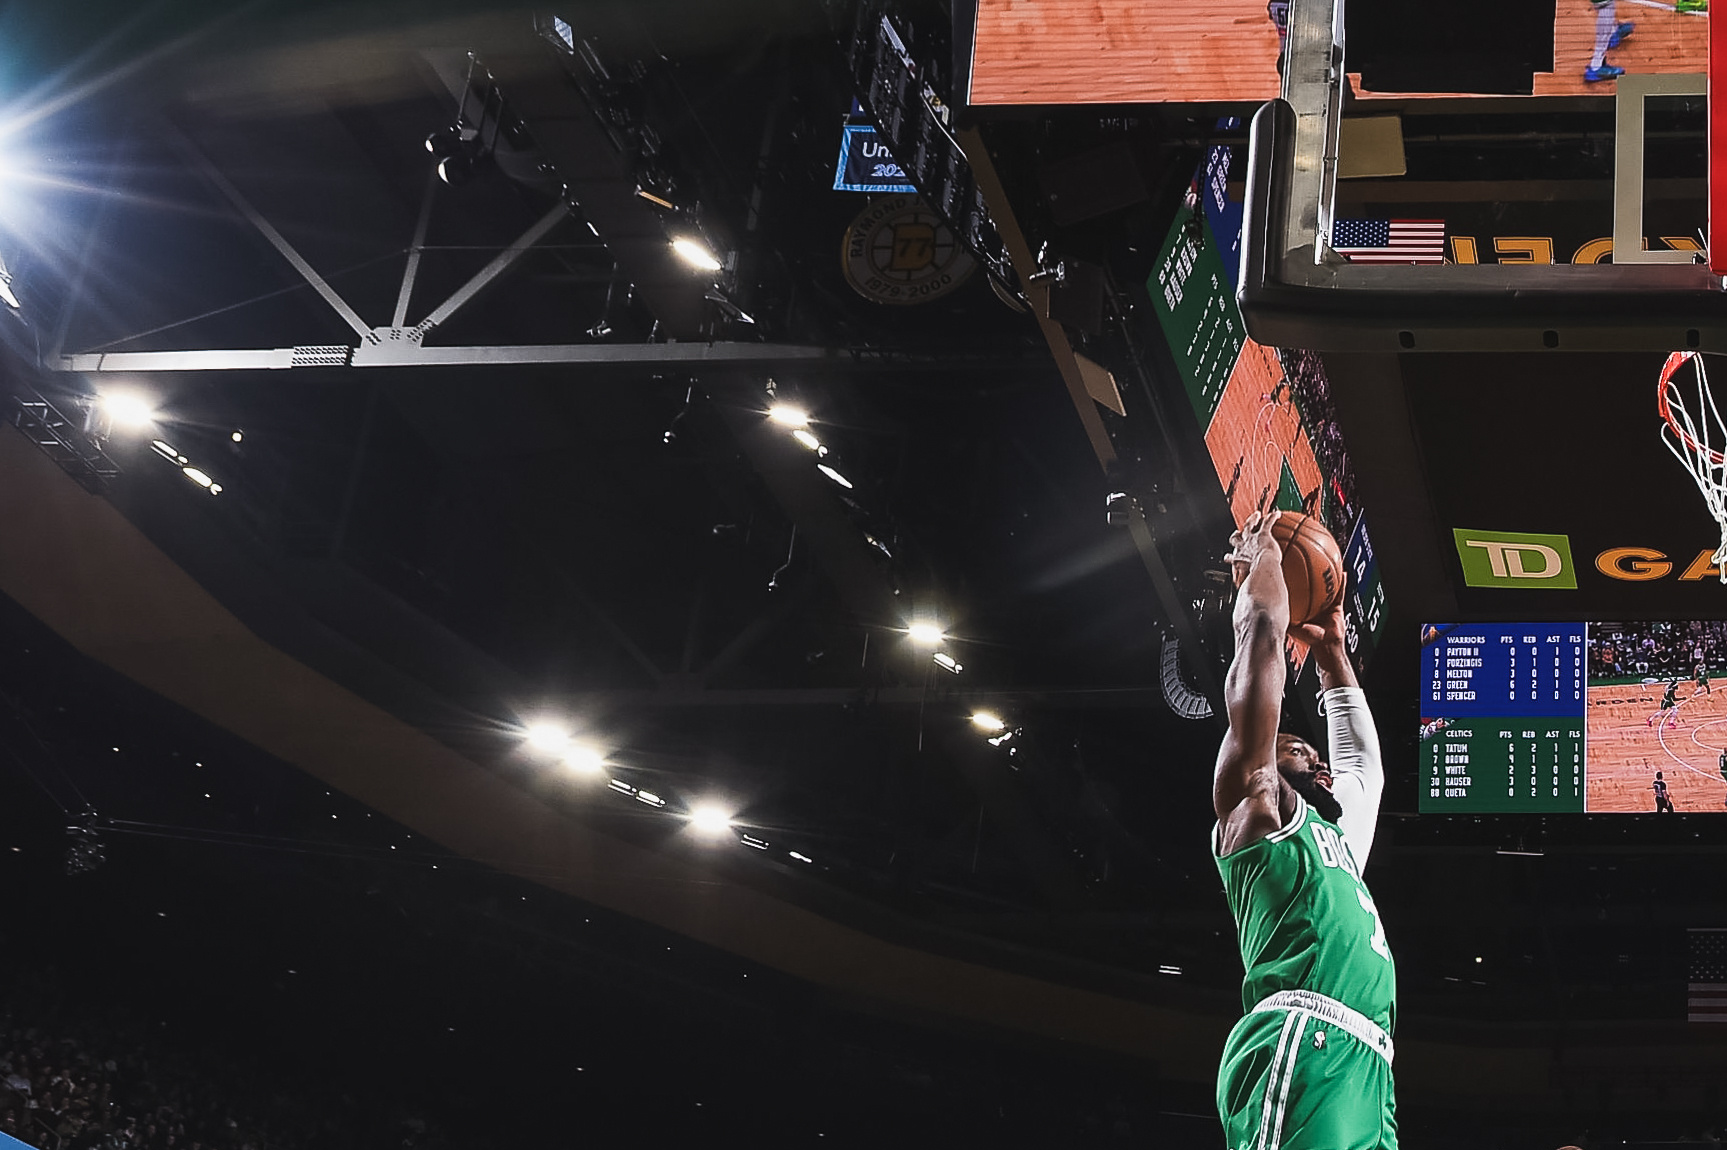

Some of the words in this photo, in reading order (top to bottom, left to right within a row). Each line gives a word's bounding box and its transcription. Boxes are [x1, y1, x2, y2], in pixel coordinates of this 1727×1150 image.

[1465, 540, 1561, 577] TD
[1447, 636, 1486, 644] WARRIORS
[1446, 681, 1468, 689] GREEN
[1446, 692, 1476, 700] SPENCER
[1445, 730, 1473, 738] CELTICS
[1445, 744, 1468, 752] TATUM
[1445, 766, 1466, 774] WHITE
[1445, 777, 1472, 786] HAUSER
[1445, 788, 1466, 797] QUETA
